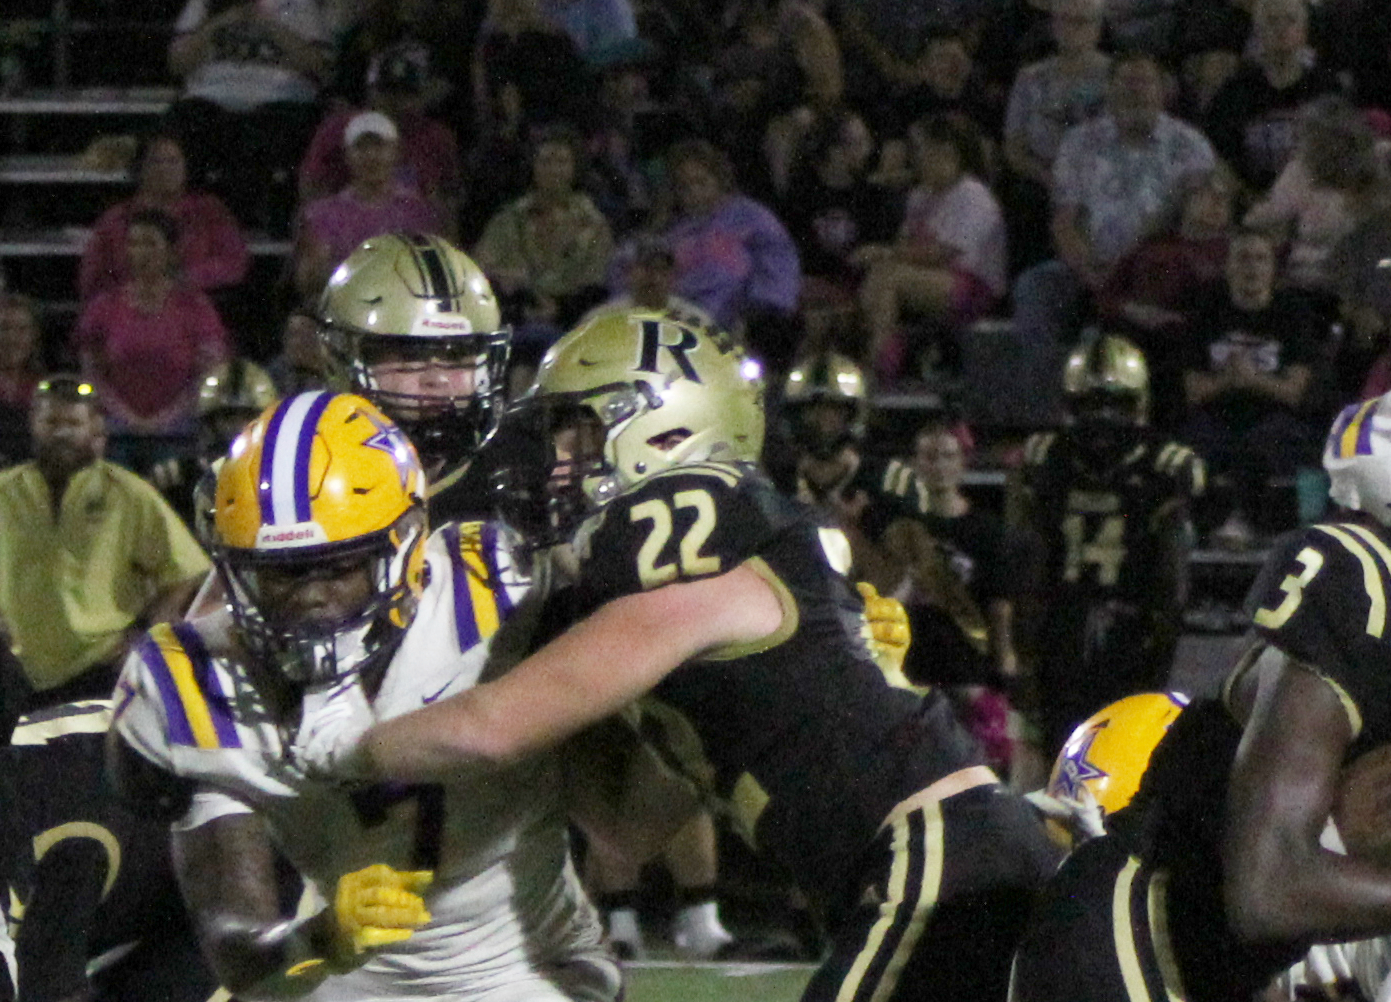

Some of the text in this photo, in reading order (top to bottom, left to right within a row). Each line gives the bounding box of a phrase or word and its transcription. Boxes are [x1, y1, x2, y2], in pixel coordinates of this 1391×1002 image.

[627, 315, 706, 386] R
[629, 488, 721, 590] 22
[1062, 514, 1126, 586] 14
[1252, 545, 1323, 629] 3
[349, 780, 446, 871] 7
